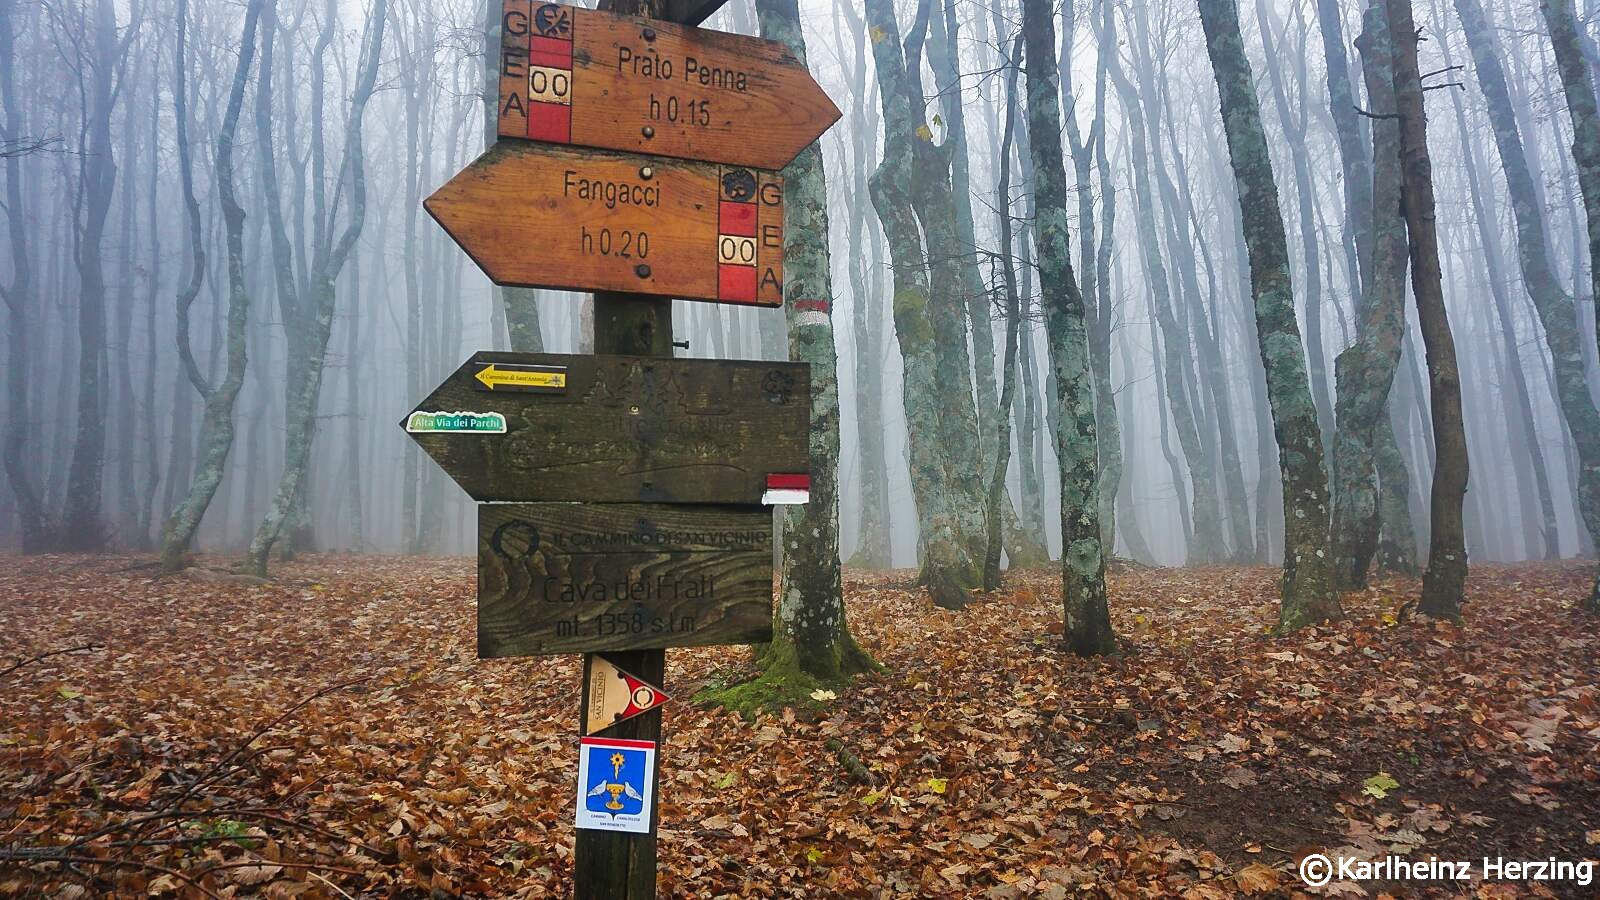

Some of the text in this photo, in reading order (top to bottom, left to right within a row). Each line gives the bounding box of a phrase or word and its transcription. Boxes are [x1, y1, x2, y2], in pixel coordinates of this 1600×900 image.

[503, 11, 527, 118] GEA
[618, 46, 748, 91] Prato Penna
[530, 69, 568, 96] 00
[563, 170, 660, 209] Fangacci
[720, 238, 756, 264] 00
[760, 183, 783, 290] GEA
[436, 418, 451, 427] Via
[453, 418, 468, 427] dei
[470, 418, 500, 428] Parchi
[554, 533, 567, 547] IL
[570, 530, 651, 547] CAMMINO
[672, 530, 704, 545] SAN
[705, 529, 767, 544] VICINIO
[543, 571, 714, 603] Cava dei Frati
[596, 614, 644, 635] 1358
[595, 671, 605, 701] VICINIO
